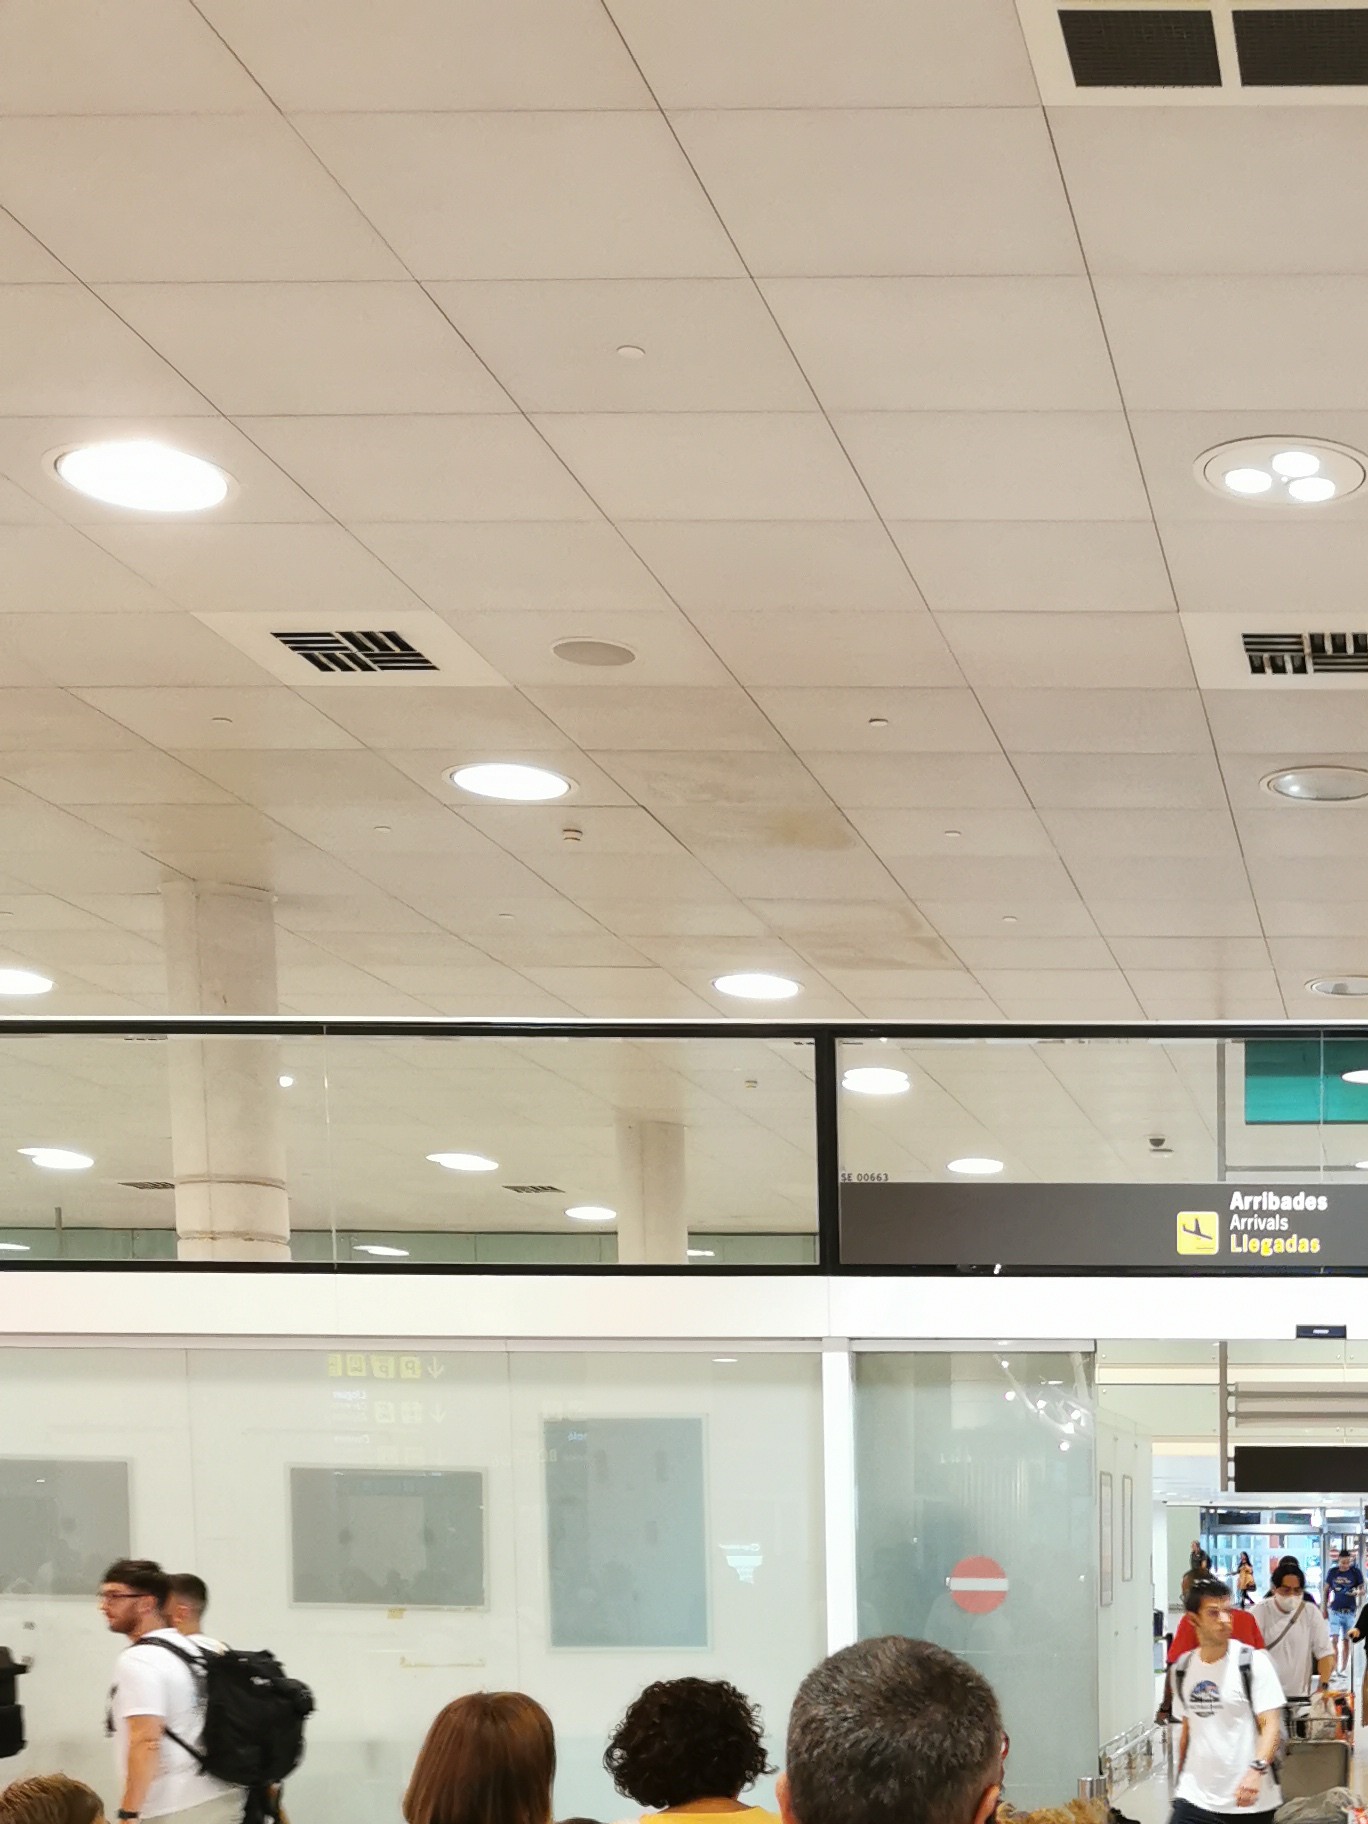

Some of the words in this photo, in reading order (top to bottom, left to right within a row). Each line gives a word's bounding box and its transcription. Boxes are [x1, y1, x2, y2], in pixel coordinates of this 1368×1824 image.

[1229, 1191, 1328, 1211] Arribades
[1229, 1214, 1289, 1231] Arrivals
[1230, 1234, 1321, 1257] Llegadas
